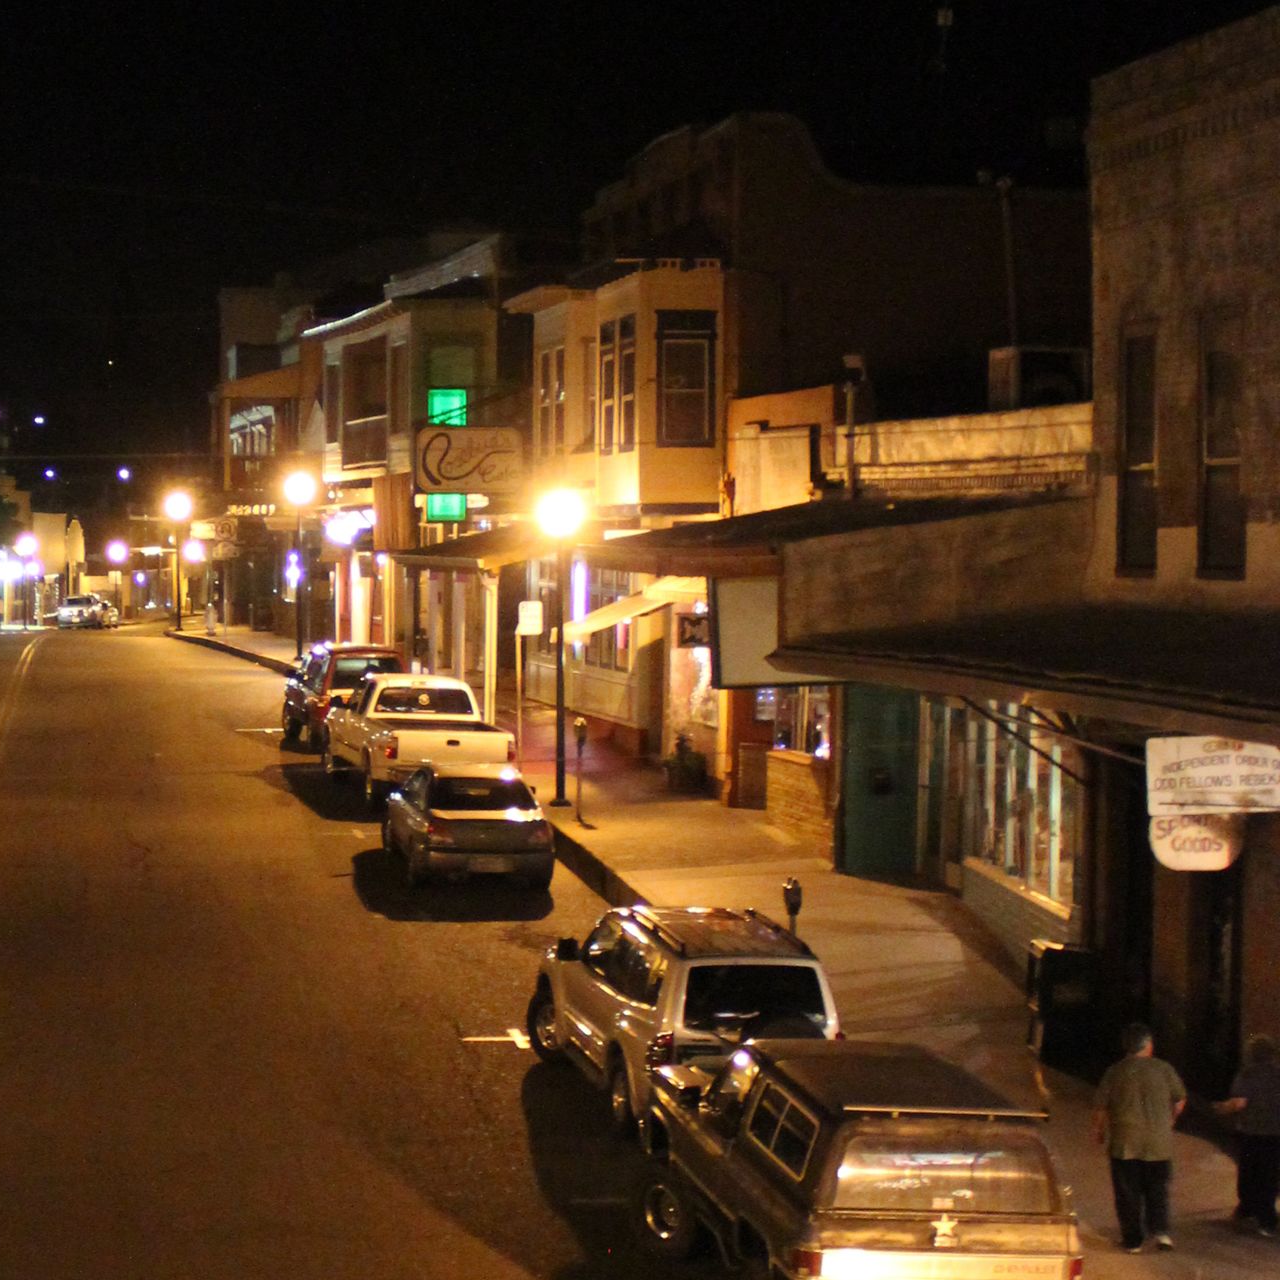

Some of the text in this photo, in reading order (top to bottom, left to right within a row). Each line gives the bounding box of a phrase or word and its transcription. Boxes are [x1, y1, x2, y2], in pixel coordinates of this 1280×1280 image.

[1162, 754, 1231, 775] INDEPENDENT
[1235, 755, 1269, 768] ORDER
[1155, 777, 1176, 790] ODD
[1179, 776, 1231, 788] FELLOWS
[1171, 836, 1222, 852] GOODS
